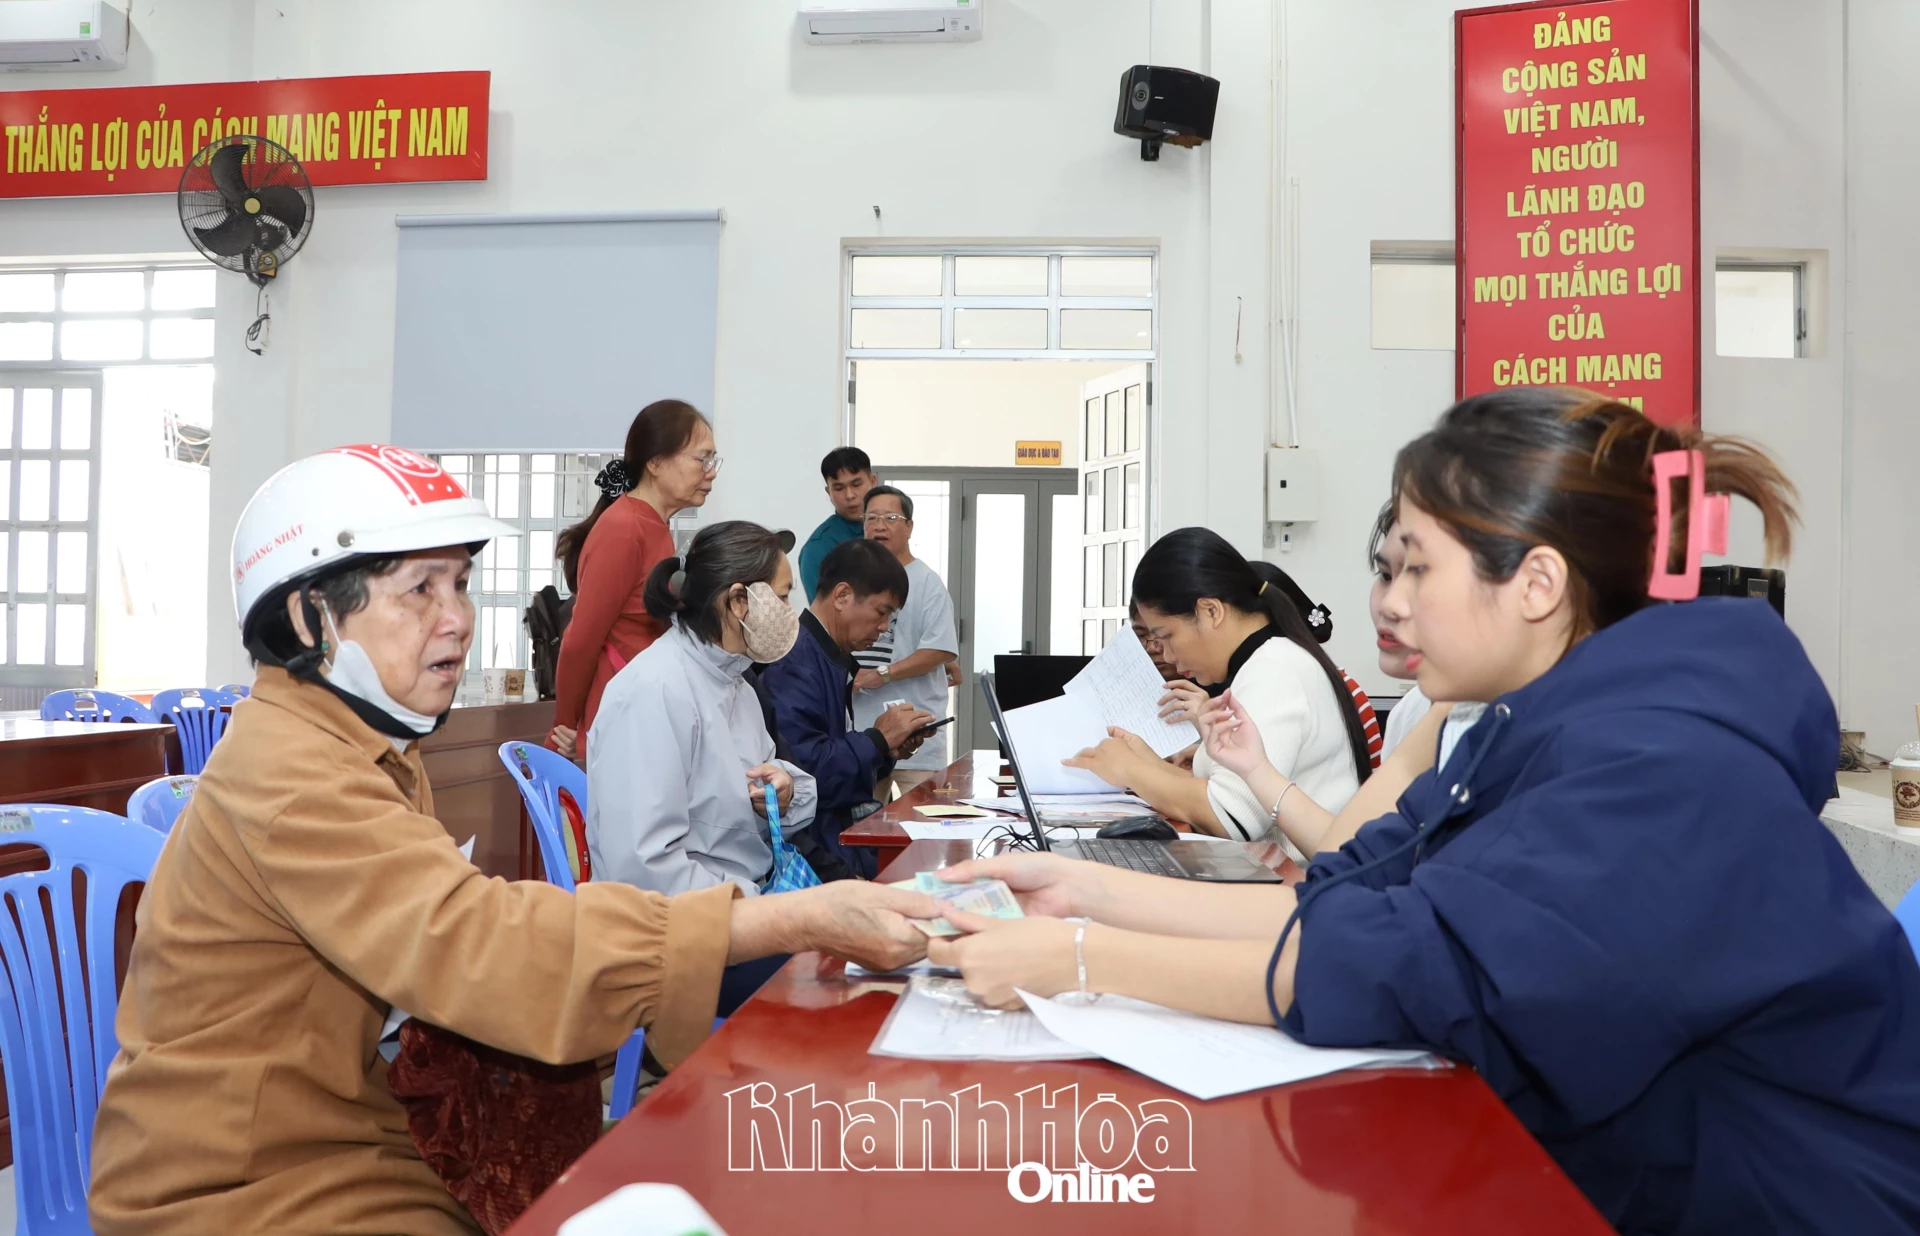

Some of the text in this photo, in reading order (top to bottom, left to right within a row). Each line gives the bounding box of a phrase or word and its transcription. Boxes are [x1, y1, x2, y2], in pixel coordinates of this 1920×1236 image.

[1534, 12, 1611, 48] ĐẢNG
[1502, 47, 1646, 98] CỘNG SẢN
[1504, 96, 1645, 138] VIỆT NAM,
[5, 99, 469, 182] THẮNG LỢI CỦA CÁCH MẠNG VIỆT NAM
[1531, 136, 1618, 174] NGƯỜI
[1506, 182, 1645, 218] LÃNH ĐẠO
[1517, 220, 1635, 258] TỔ CHỨC
[1474, 260, 1682, 307] MỌI THẮNG LỢI
[1548, 305, 1605, 340] CỦA
[1493, 353, 1662, 387] CÁCH MẠNG
[244, 523, 304, 571] HOÀNG NHẬT
